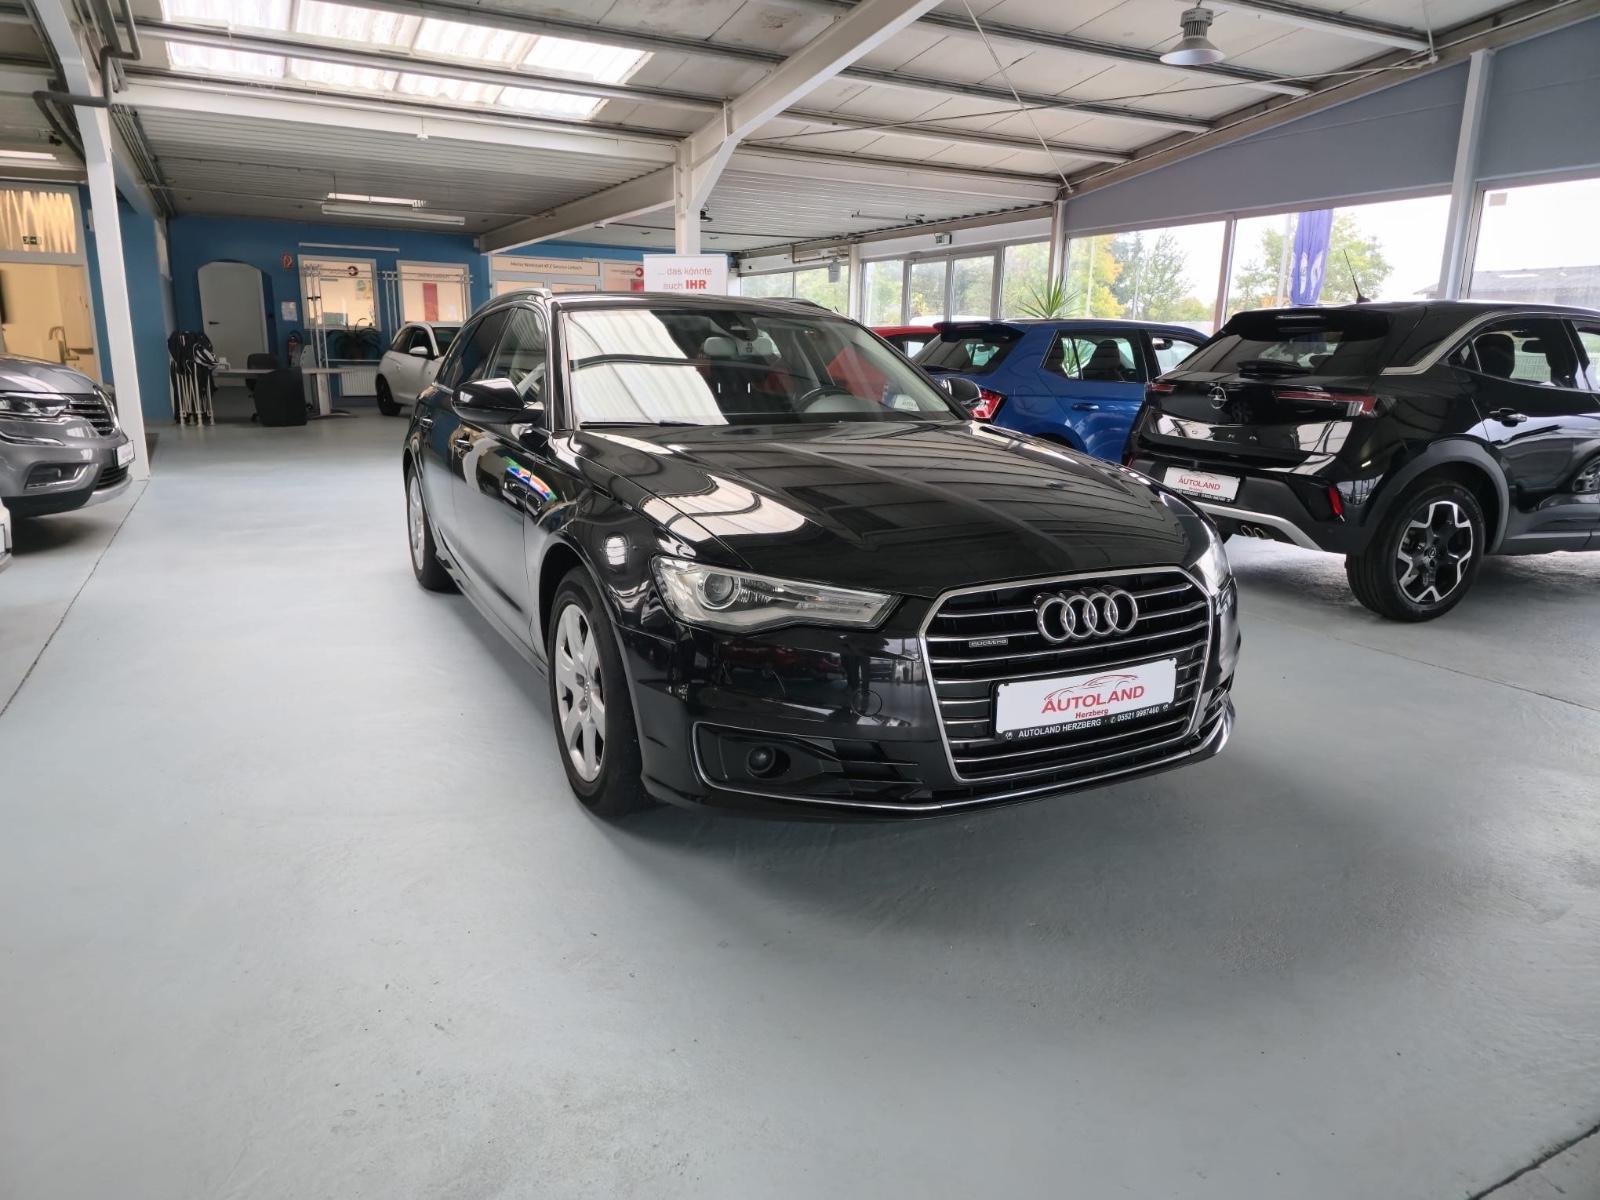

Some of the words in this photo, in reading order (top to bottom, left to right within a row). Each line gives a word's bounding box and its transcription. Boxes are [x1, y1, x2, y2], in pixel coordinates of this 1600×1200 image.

[666, 265, 683, 276] das
[684, 265, 712, 276] könnte
[663, 280, 683, 290] auch
[685, 279, 707, 290] IHR
[1178, 477, 1221, 490] AUTOLAND
[1041, 686, 1145, 714] AUTOLAND
[1075, 708, 1109, 719] Herzberg
[1018, 725, 1061, 738] AUTOLAND
[1062, 718, 1102, 732] HERZBERG
